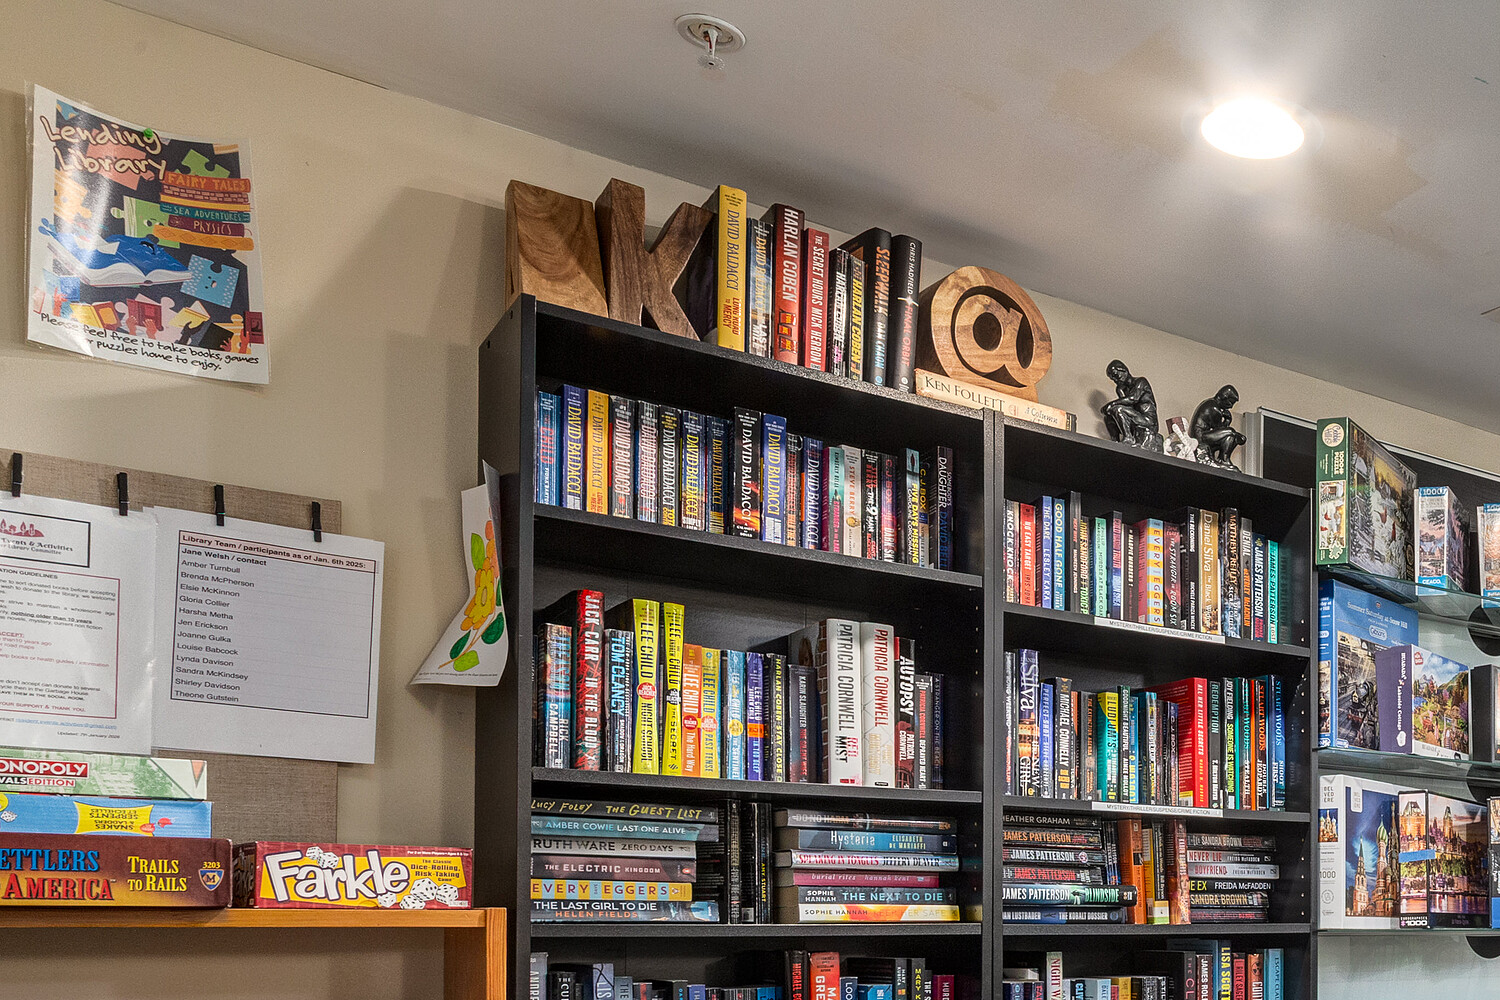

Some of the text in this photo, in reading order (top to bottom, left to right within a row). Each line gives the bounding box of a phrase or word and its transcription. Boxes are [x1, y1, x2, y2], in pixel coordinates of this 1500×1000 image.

[40, 115, 162, 155] Lending
[54, 147, 166, 180] Library
[169, 173, 246, 190] FAIRY TALES
[174, 205, 242, 221] SEA ADVENTURES
[727, 209, 740, 290] DAVID BALDACCI
[782, 208, 799, 302] HARLAN COBEN
[813, 247, 824, 278] SECRET
[812, 278, 823, 306] HOURS
[874, 246, 890, 317] SLEEPWALK
[811, 307, 823, 329] MICK
[84, 326, 107, 339] feel
[111, 332, 138, 346] free
[142, 338, 154, 348] to
[157, 342, 186, 354] take
[189, 347, 223, 361] books,
[225, 354, 259, 365] games
[810, 329, 822, 364] HERRON
[901, 305, 913, 367] FINAL ORBIT
[97, 341, 222, 372] puzzles home to enjoy.
[925, 376, 1005, 412] KEN FOLLETT
[567, 406, 582, 495] DAVID BALDACCI
[742, 428, 753, 519] DAVID BALDACCI
[182, 535, 212, 546] Library
[214, 540, 237, 549] Team
[243, 544, 290, 558] participants
[314, 556, 330, 564] Jan.
[332, 558, 344, 566] 6th
[346, 560, 366, 568] 2025:
[182, 548, 267, 566] Jane Welsh contact
[19, 570, 58, 579] GUIDELINES
[182, 559, 240, 573] Amber Turnbull
[181, 572, 254, 588] Brenda McPherson
[181, 584, 240, 597] Elsie McKinnon
[179, 595, 230, 608] Gloria Collier
[179, 608, 233, 620] Harsha Metha
[177, 631, 206, 639] Joanne
[195, 621, 228, 630] Erickson
[177, 643, 238, 655] Louise Babcock
[640, 622, 654, 679] LEE CHILD
[176, 655, 233, 666] Lynda Davison
[176, 667, 248, 681] Sandra McKindsey
[585, 595, 599, 749] JACK CARR IN THE BLOOD
[837, 624, 855, 731] PATRICIA CORNWELL
[175, 678, 240, 690] Shirley Davidson
[900, 655, 914, 716] AUTOPSY
[175, 690, 239, 702] Theone Gutstein
[1059, 694, 1070, 767] MICHAEL CONNELLY
[0, 760, 87, 776] ONOPOLY
[29, 779, 75, 787] EDITION
[531, 800, 702, 820] LUCY FOLEY THE GUEST LIST
[533, 838, 673, 852] RUTH WARE ZERO DAYS
[0, 849, 99, 872] ETTLERS
[128, 856, 179, 874] TRAILS
[411, 864, 461, 872] Dice-Rolling,
[128, 875, 187, 892] TO RAILS
[264, 850, 409, 902] Farkle
[1320, 871, 1336, 879] 1000
[4, 873, 114, 900] AMERICA
[843, 892, 943, 901] THE NEXT TO DIE
[1002, 888, 1027, 900] JAMES
[1029, 888, 1070, 900] PATTERSON
[1221, 947, 1231, 969] LISA
[1051, 958, 1062, 989] NIGHT
